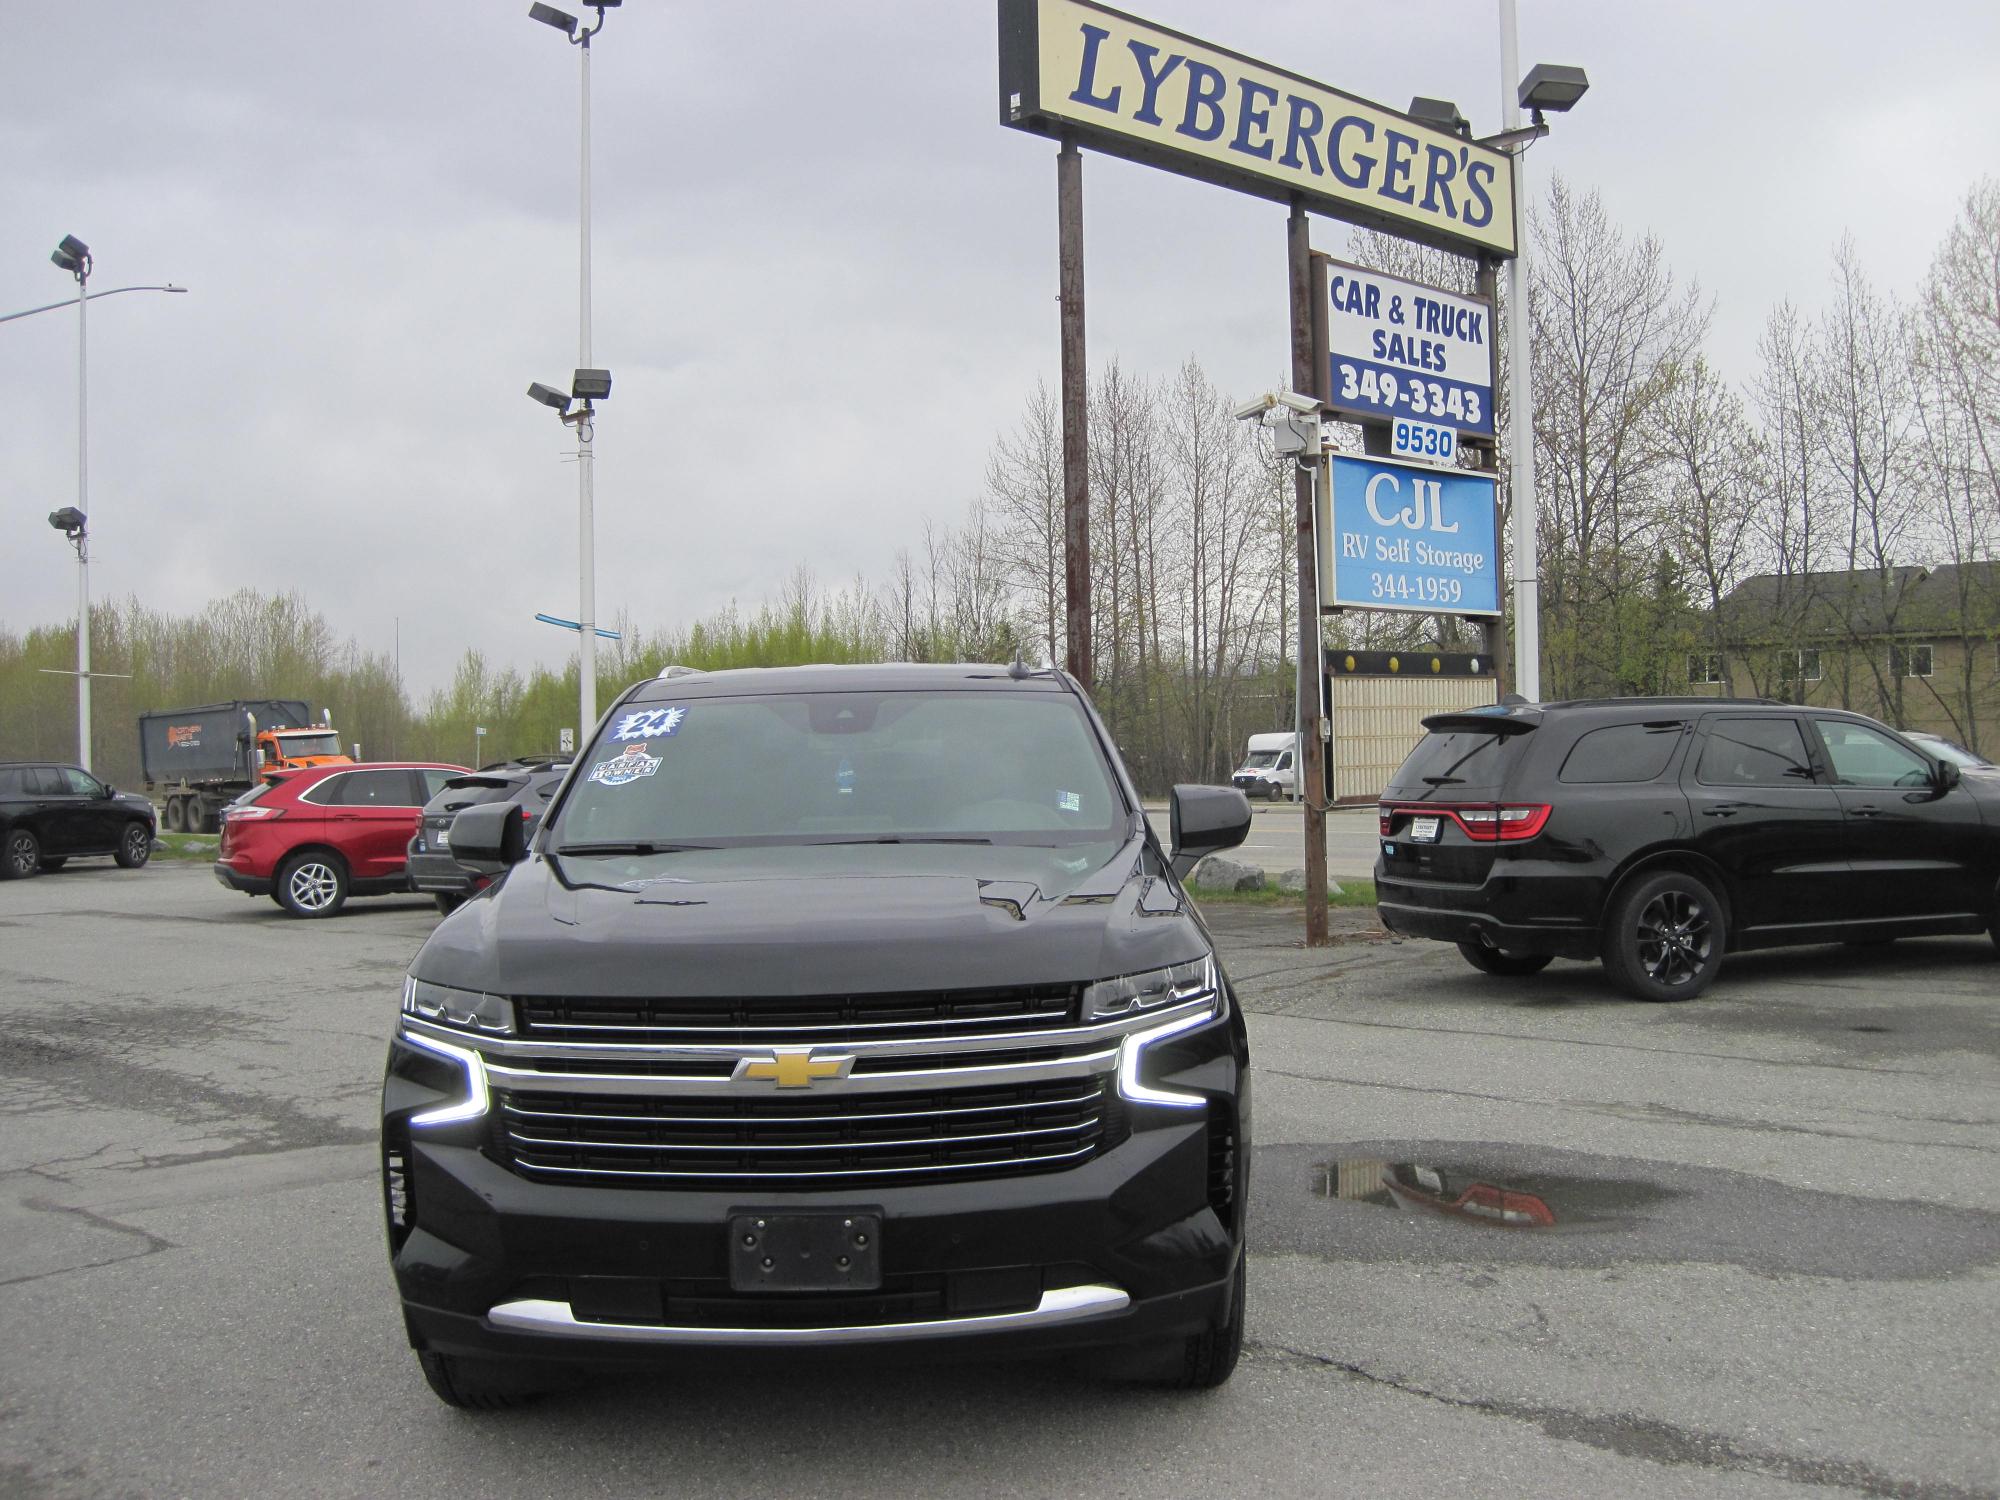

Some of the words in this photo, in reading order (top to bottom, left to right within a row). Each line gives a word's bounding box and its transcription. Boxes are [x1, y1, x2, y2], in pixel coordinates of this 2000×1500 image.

[1068, 22, 1495, 228] LYBERGER'S
[1330, 275, 1381, 320] CAR
[1388, 295, 1405, 326] &
[1413, 296, 1483, 345] TRUCK
[1372, 328, 1447, 373] SALES
[1339, 363, 1482, 424] 349-3343
[1395, 423, 1452, 458] 9530
[1365, 472, 1459, 534] CJL
[1342, 532, 1369, 559] RV
[1375, 536, 1410, 564] Self
[1415, 540, 1485, 575] Storage
[1371, 572, 1463, 603] 344-1959
